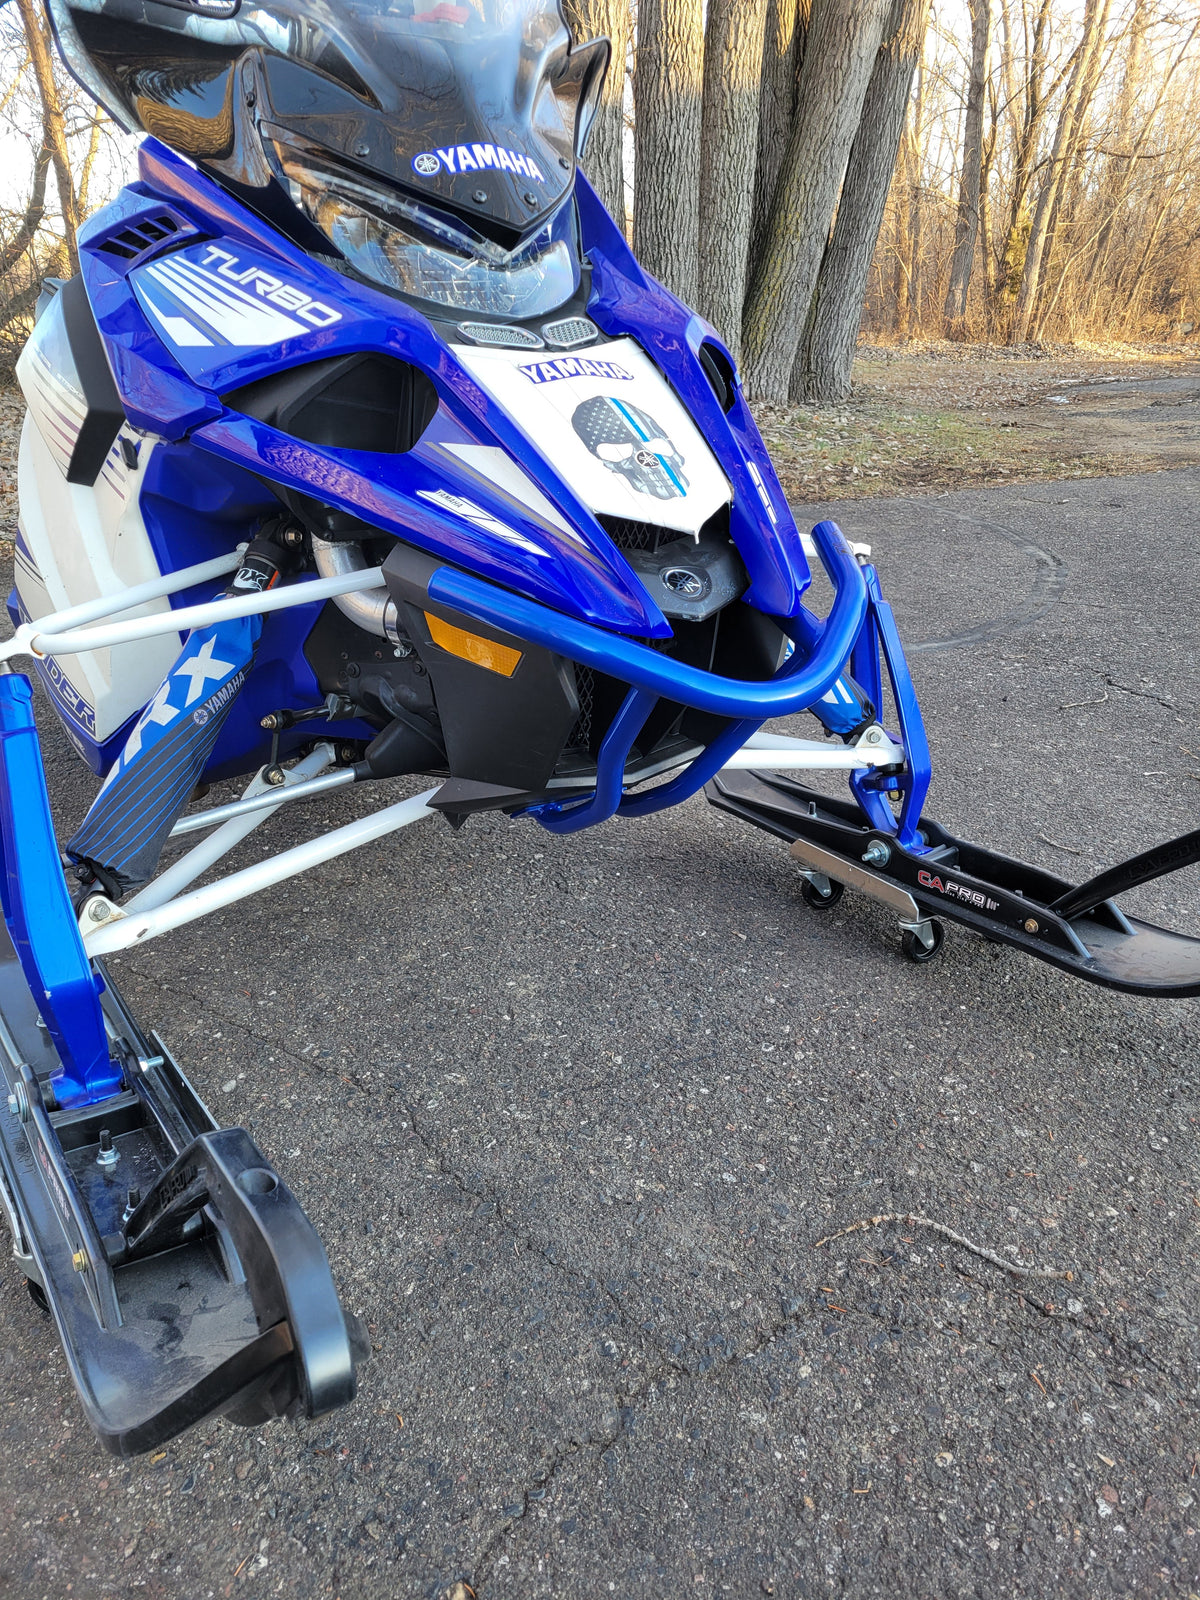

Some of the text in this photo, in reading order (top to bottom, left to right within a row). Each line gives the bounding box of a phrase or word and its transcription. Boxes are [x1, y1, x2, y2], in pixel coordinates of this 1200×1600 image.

[436, 143, 546, 183] YAMAHA
[200, 244, 344, 328] TURBO
[519, 357, 633, 384] YAMAHA
[436, 489, 464, 509] YAMAHA
[205, 670, 246, 715] YAMAHA
